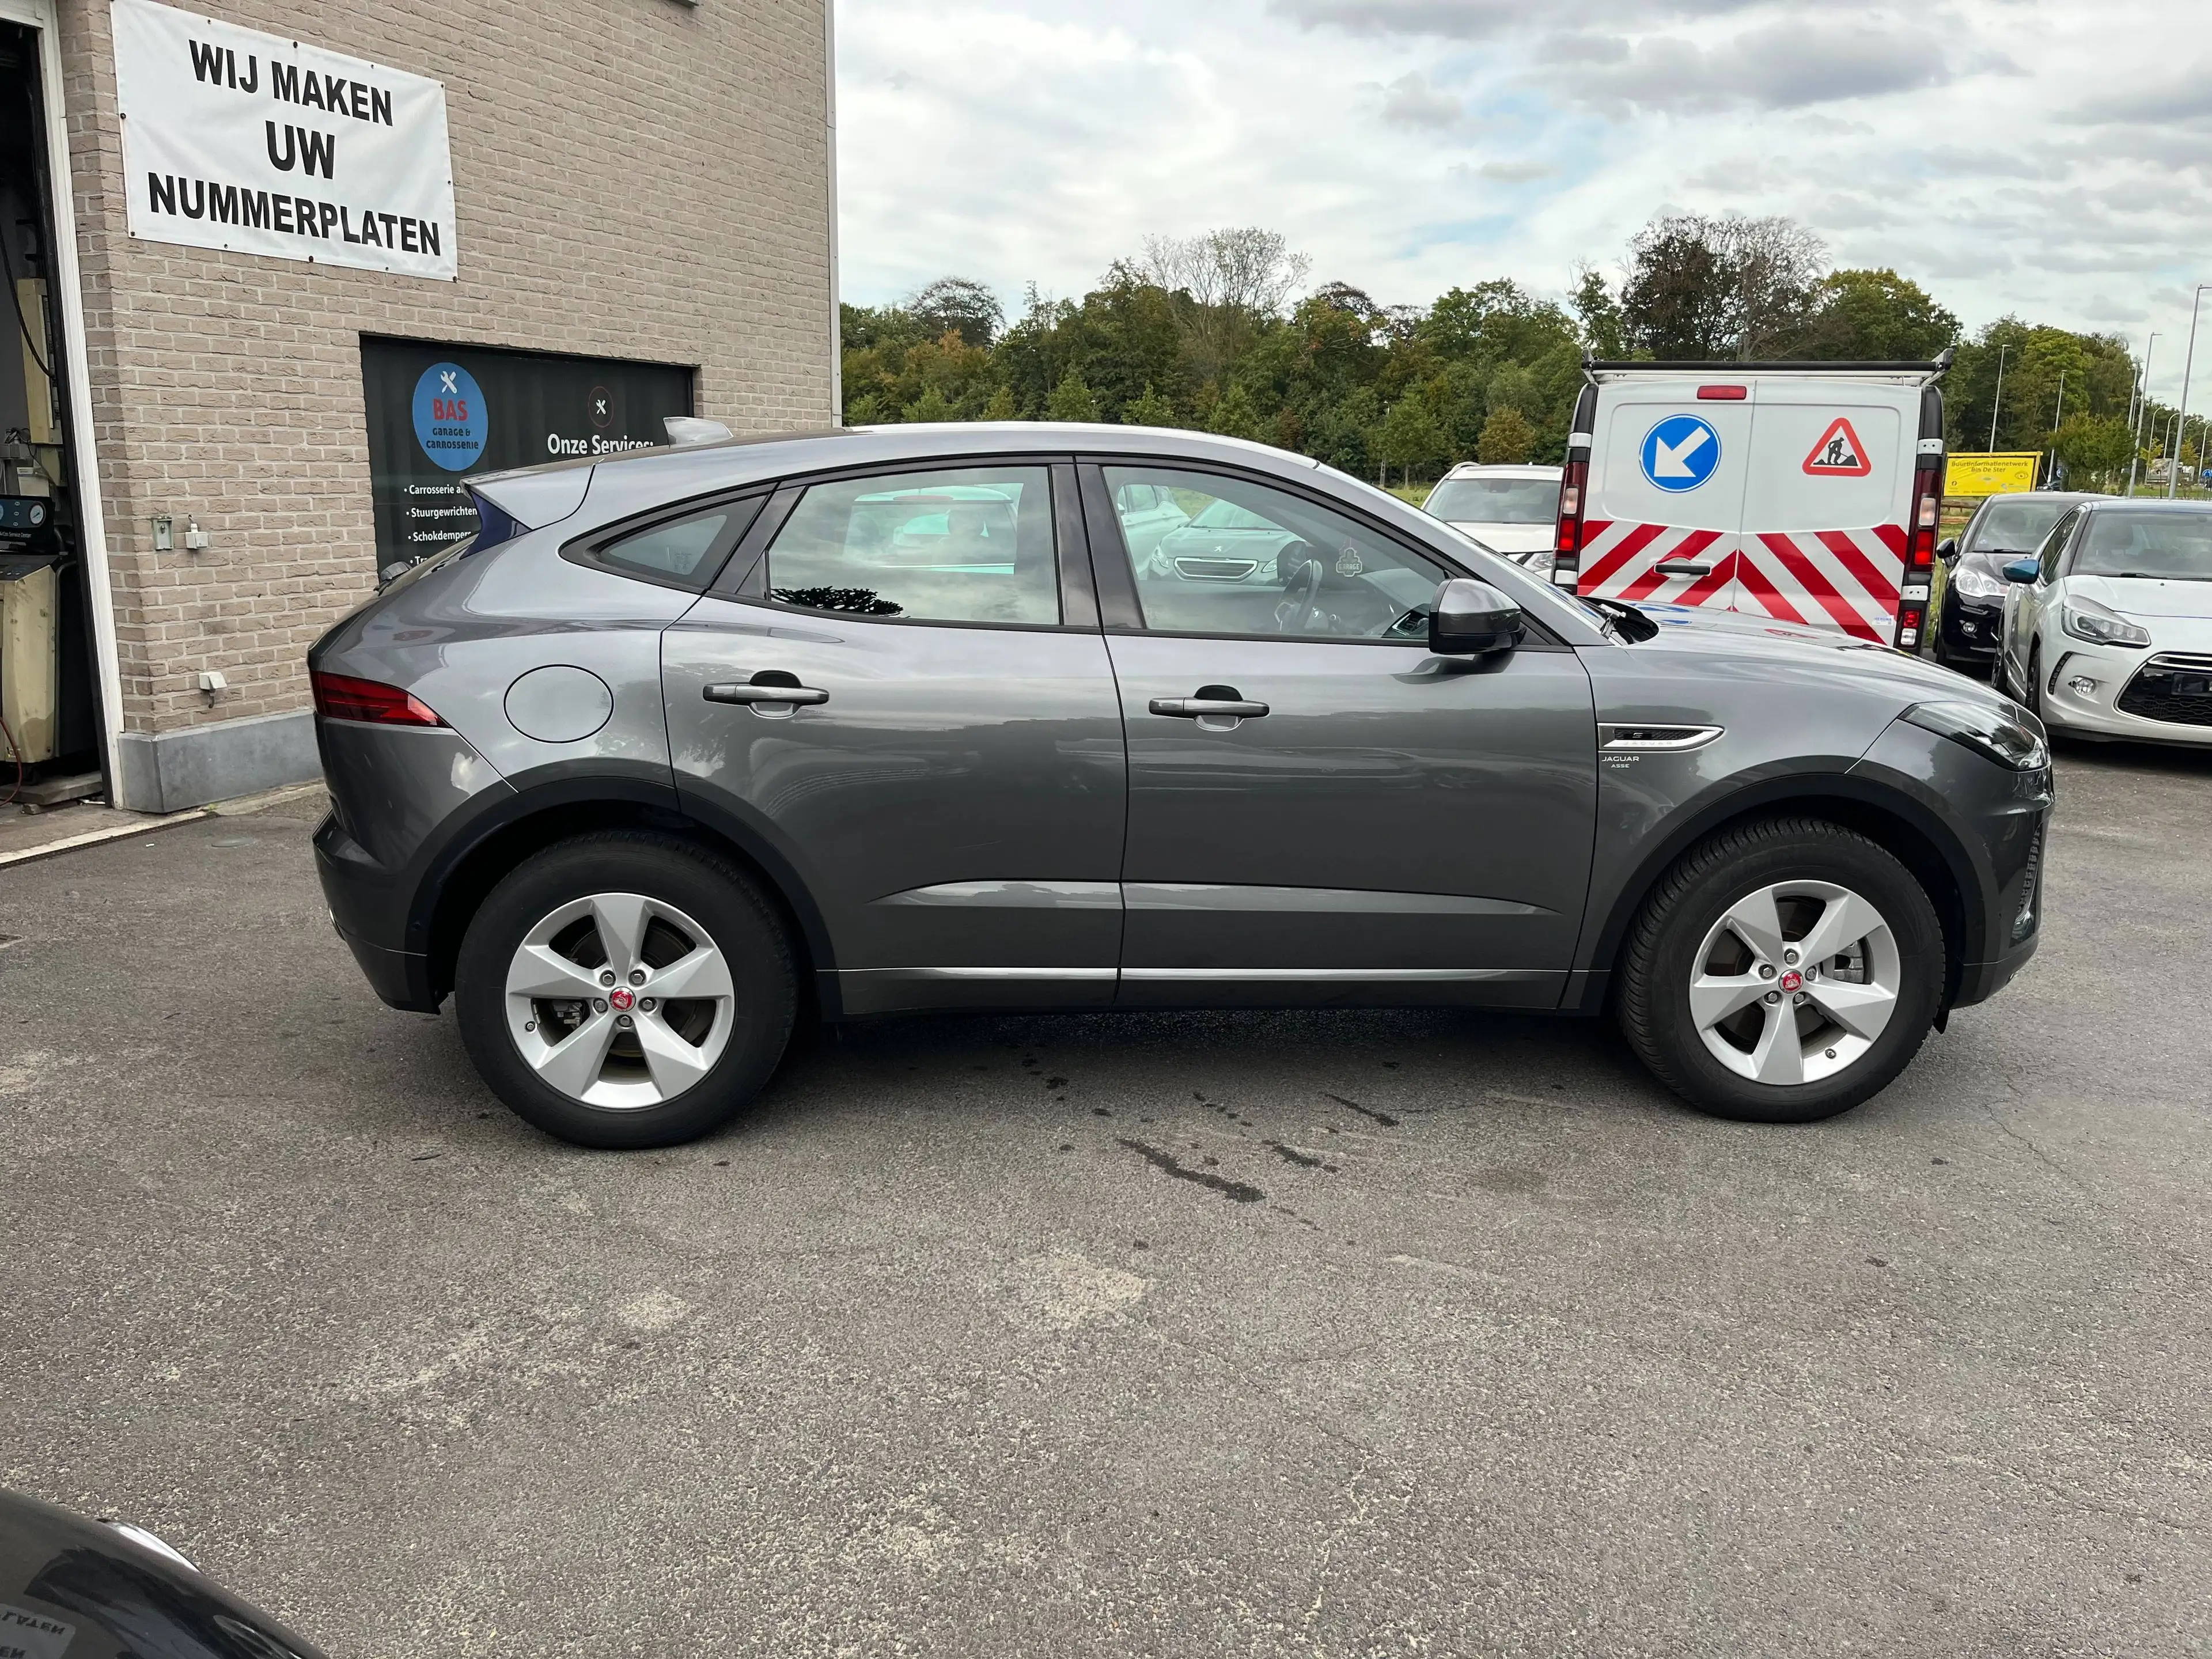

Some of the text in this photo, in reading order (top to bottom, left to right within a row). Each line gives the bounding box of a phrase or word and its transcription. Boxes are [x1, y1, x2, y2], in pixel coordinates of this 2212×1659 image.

[188, 39, 393, 127] WIJ MAKEN
[265, 120, 335, 180] UW
[148, 172, 441, 256] NUMMERPLATEN
[434, 398, 468, 421] BAS
[547, 434, 588, 454] Onze
[409, 484, 454, 494] Carrosserie
[411, 506, 478, 519] Stuurgewrichten
